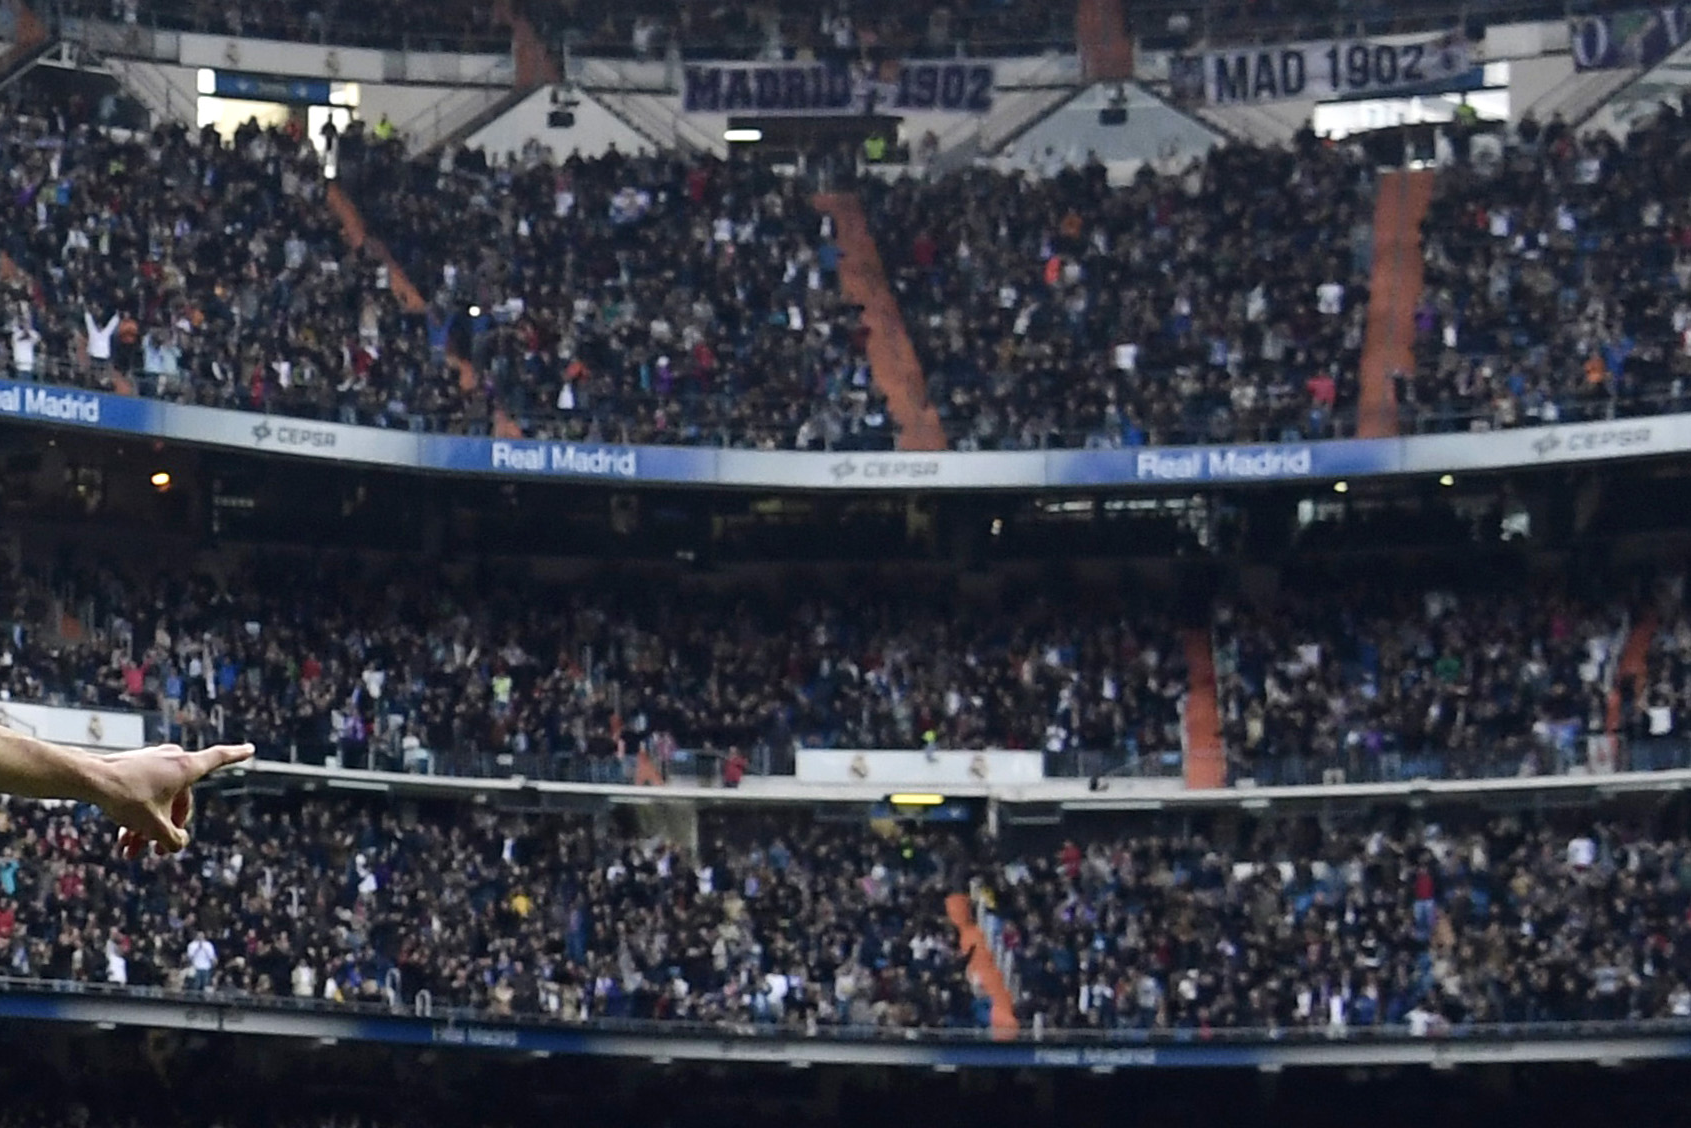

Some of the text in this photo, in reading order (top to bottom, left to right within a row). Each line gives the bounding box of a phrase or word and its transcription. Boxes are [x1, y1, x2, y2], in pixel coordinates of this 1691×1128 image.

[1214, 43, 1425, 102] MAD 1902
[25, 387, 100, 423] Madrid
[276, 426, 337, 448] CEPSA
[492, 441, 636, 477] Real Madrid
[1137, 448, 1312, 479] Real Madrid
